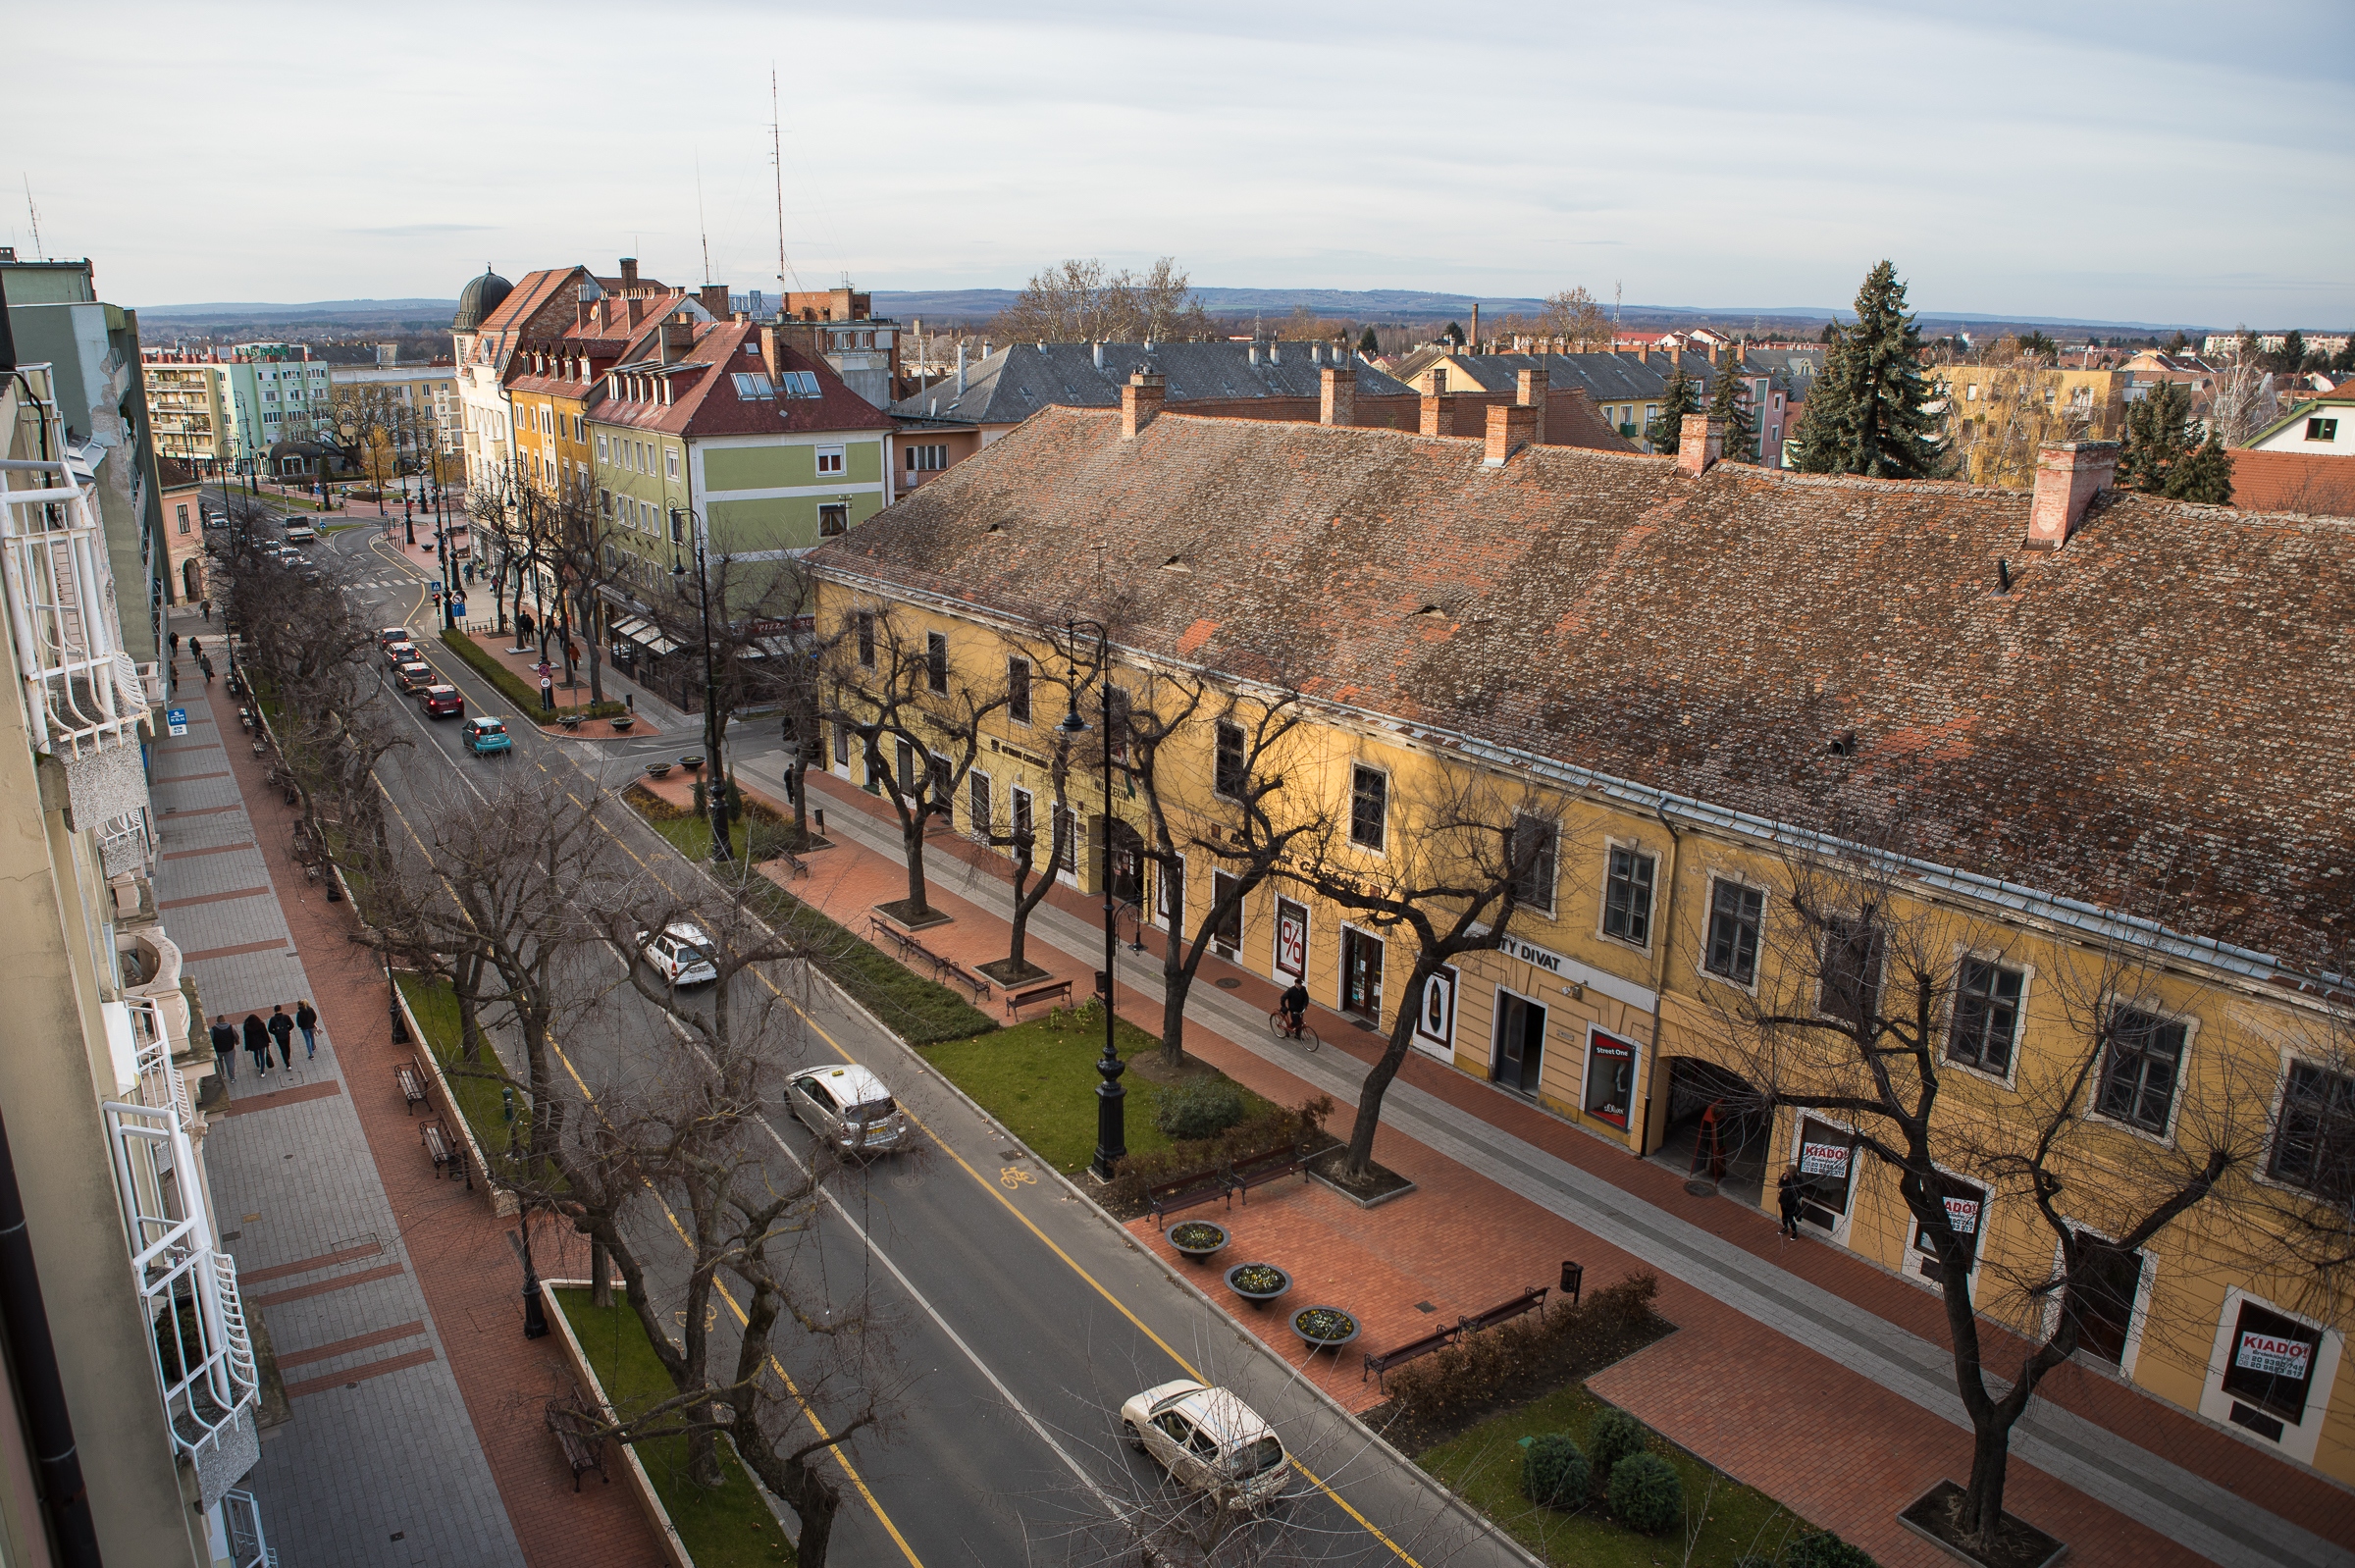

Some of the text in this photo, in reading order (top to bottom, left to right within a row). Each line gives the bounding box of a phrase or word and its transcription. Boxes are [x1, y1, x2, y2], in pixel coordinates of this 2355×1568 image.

[259, 346, 288, 356] BANK
[1521, 945, 1561, 971] DIVAT
[1596, 1047, 1615, 1056] Street
[2243, 1335, 2309, 1359] KIADÓ!
